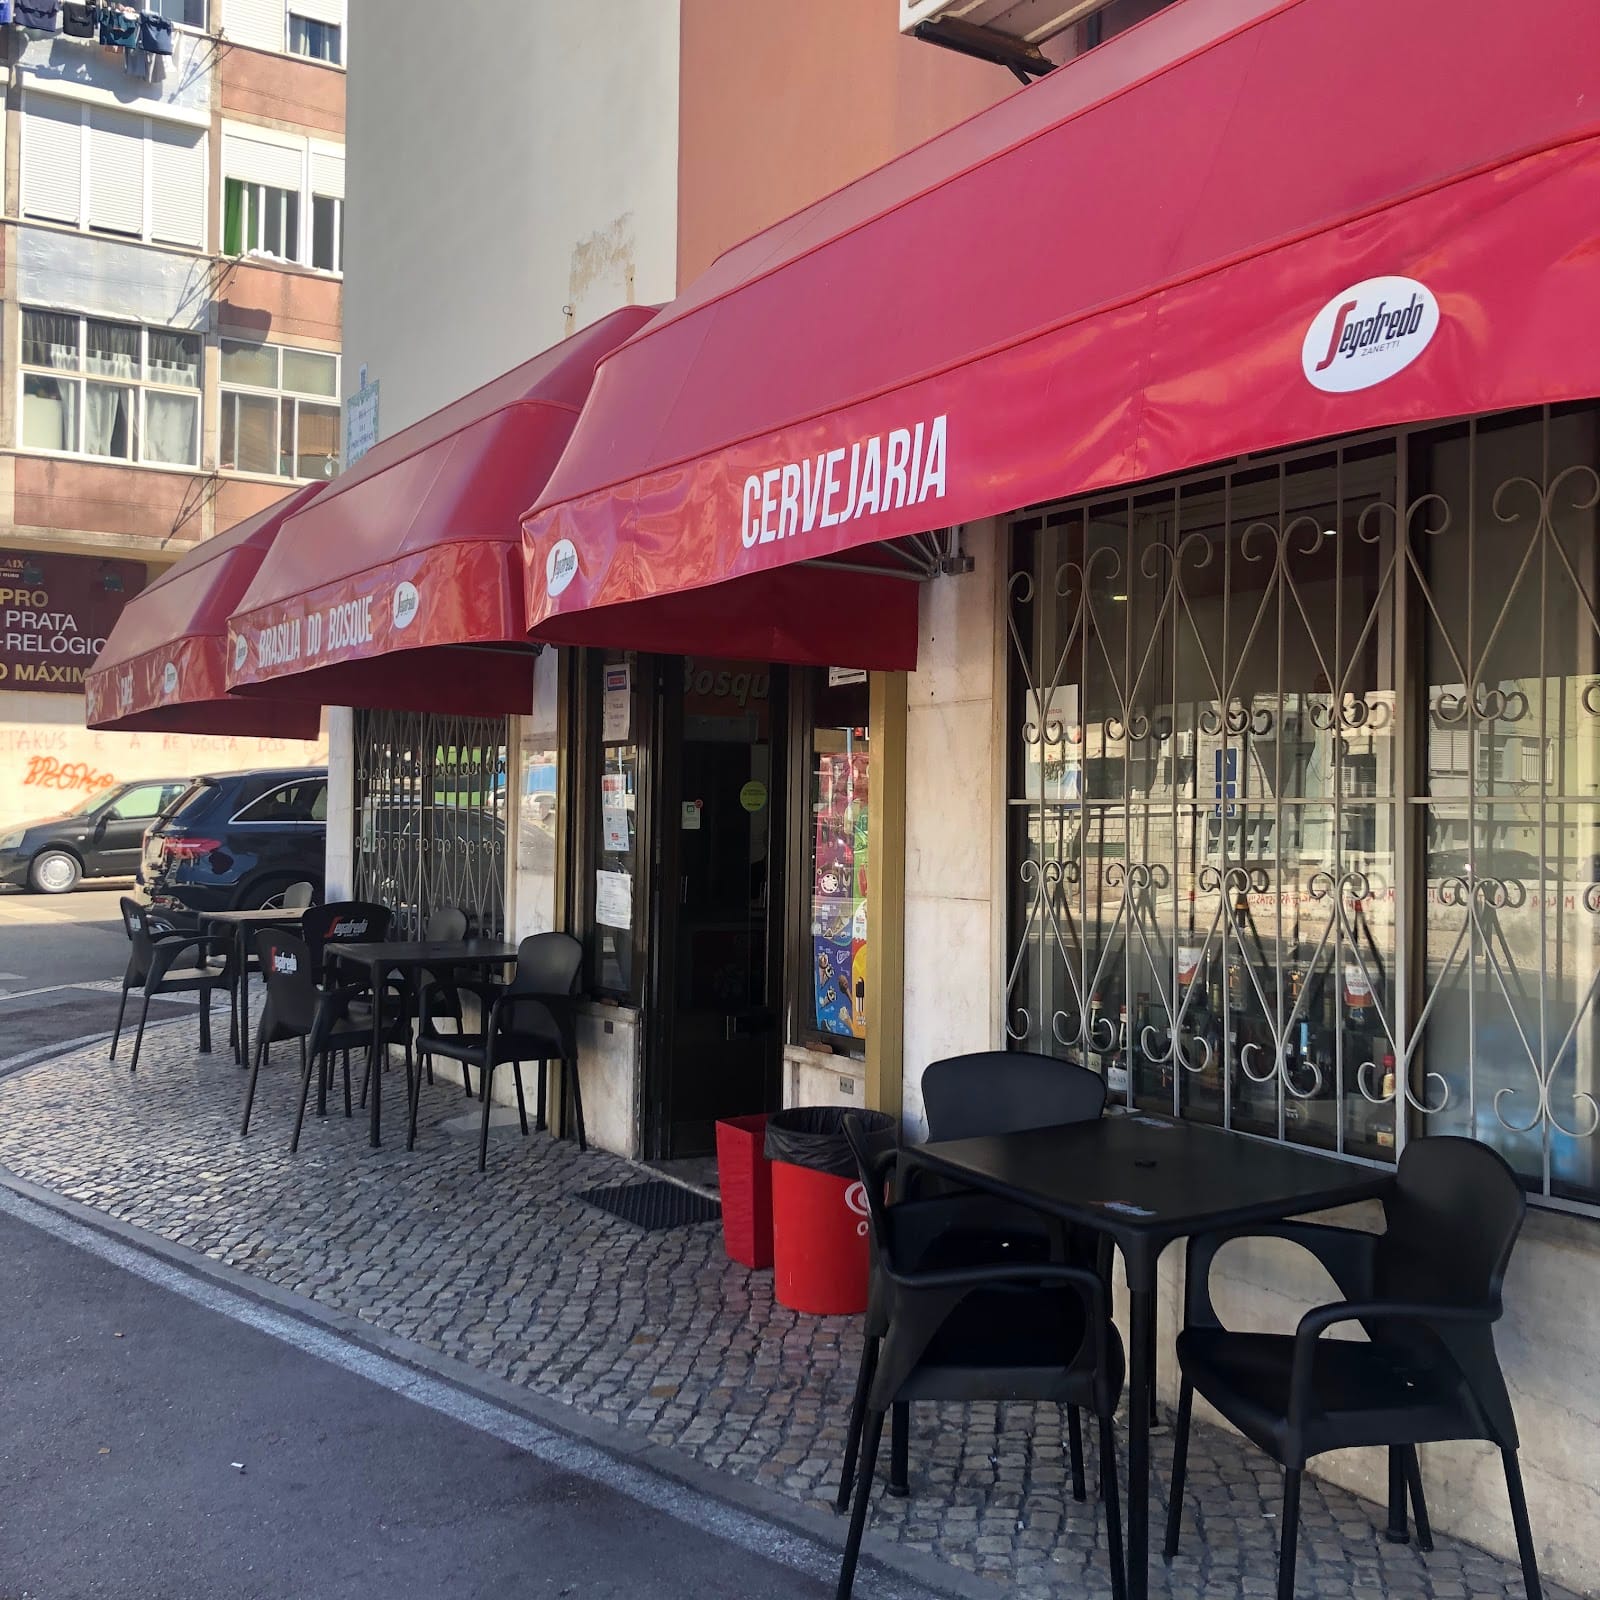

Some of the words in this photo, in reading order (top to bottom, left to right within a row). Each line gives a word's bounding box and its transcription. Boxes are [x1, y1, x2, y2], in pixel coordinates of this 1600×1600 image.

[1315, 292, 1424, 371] Segafredo
[1361, 340, 1400, 356] ZANETTI
[741, 415, 947, 548] CERVEJARIA
[5, 609, 78, 632] PRATA
[258, 613, 300, 669] BRASÍLIA
[307, 612, 322, 657] DO
[327, 595, 373, 651] BOSQUE
